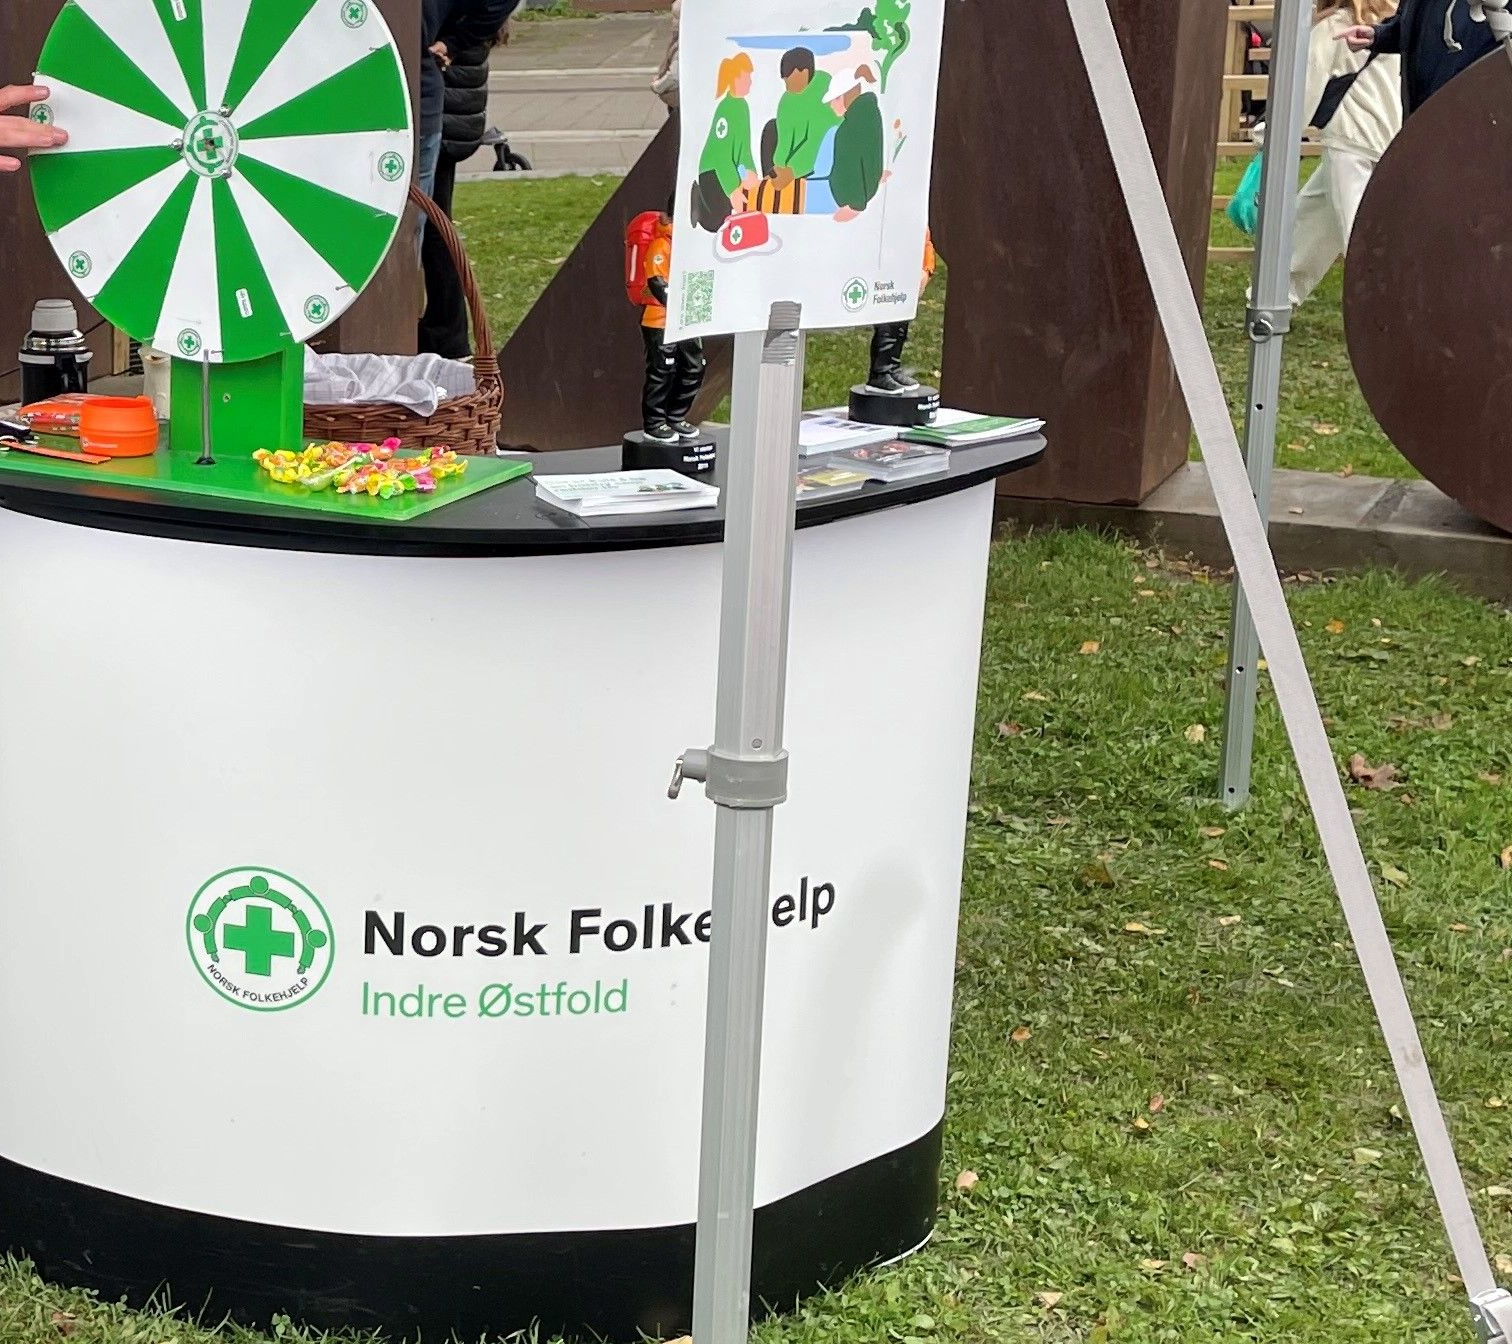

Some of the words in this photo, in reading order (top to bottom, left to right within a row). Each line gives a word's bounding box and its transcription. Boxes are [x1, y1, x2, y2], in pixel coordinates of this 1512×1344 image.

[362, 909, 548, 958] Norsk
[569, 876, 836, 954] Folkeelp
[206, 964, 240, 996] NORSK
[242, 977, 310, 1003] FOLKEHJELP
[362, 980, 468, 1019] Indre
[476, 977, 629, 1019] Østfold
